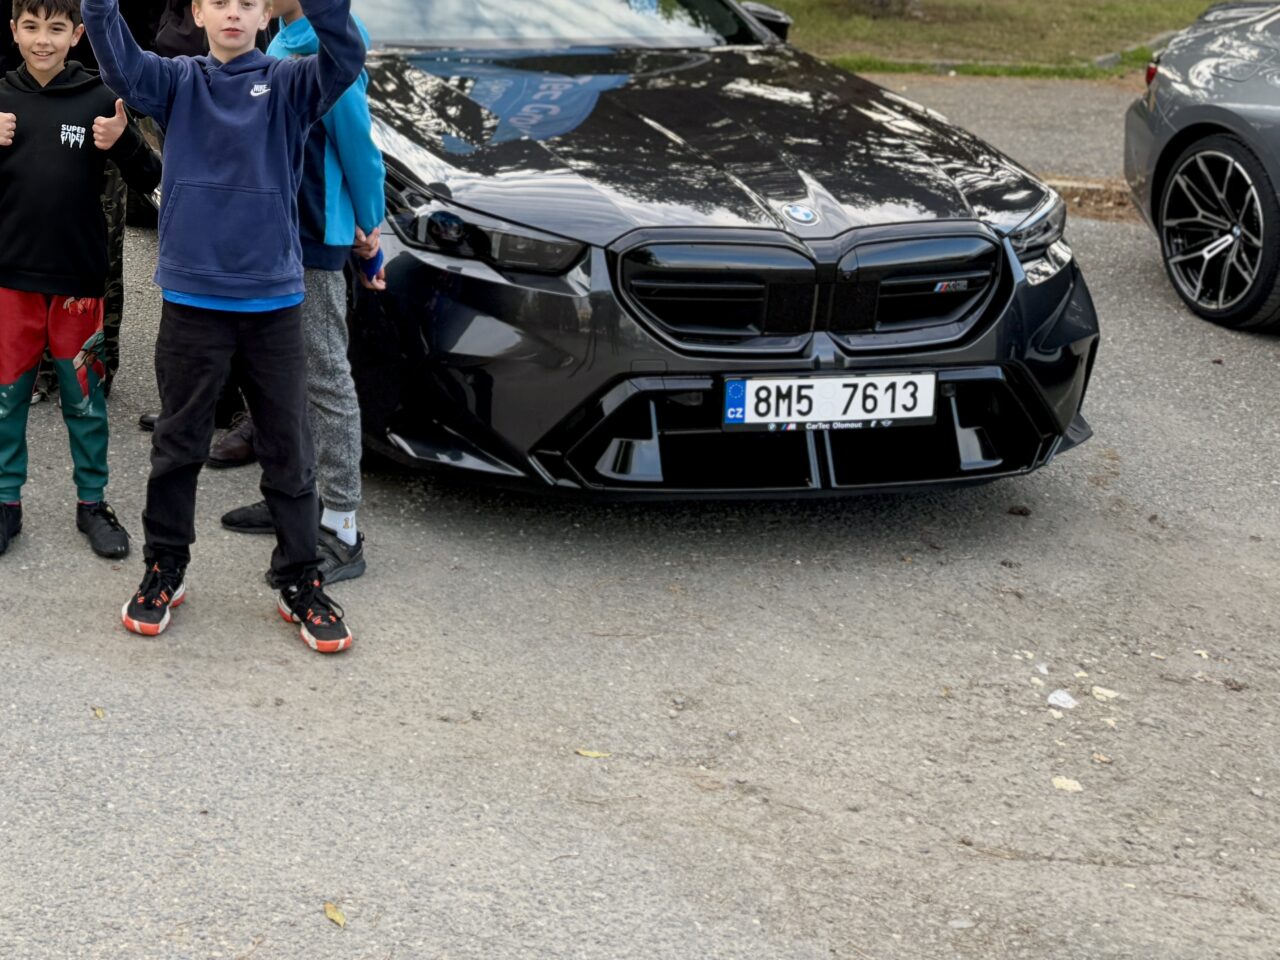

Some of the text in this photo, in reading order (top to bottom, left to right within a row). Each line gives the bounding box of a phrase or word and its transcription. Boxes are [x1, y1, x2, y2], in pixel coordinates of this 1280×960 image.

[61, 124, 86, 134] SUPER
[754, 381, 919, 418] 8M5 7613
[727, 407, 744, 419] CZ
[805, 422, 830, 430] CarTec
[832, 421, 863, 429] Olomouc
